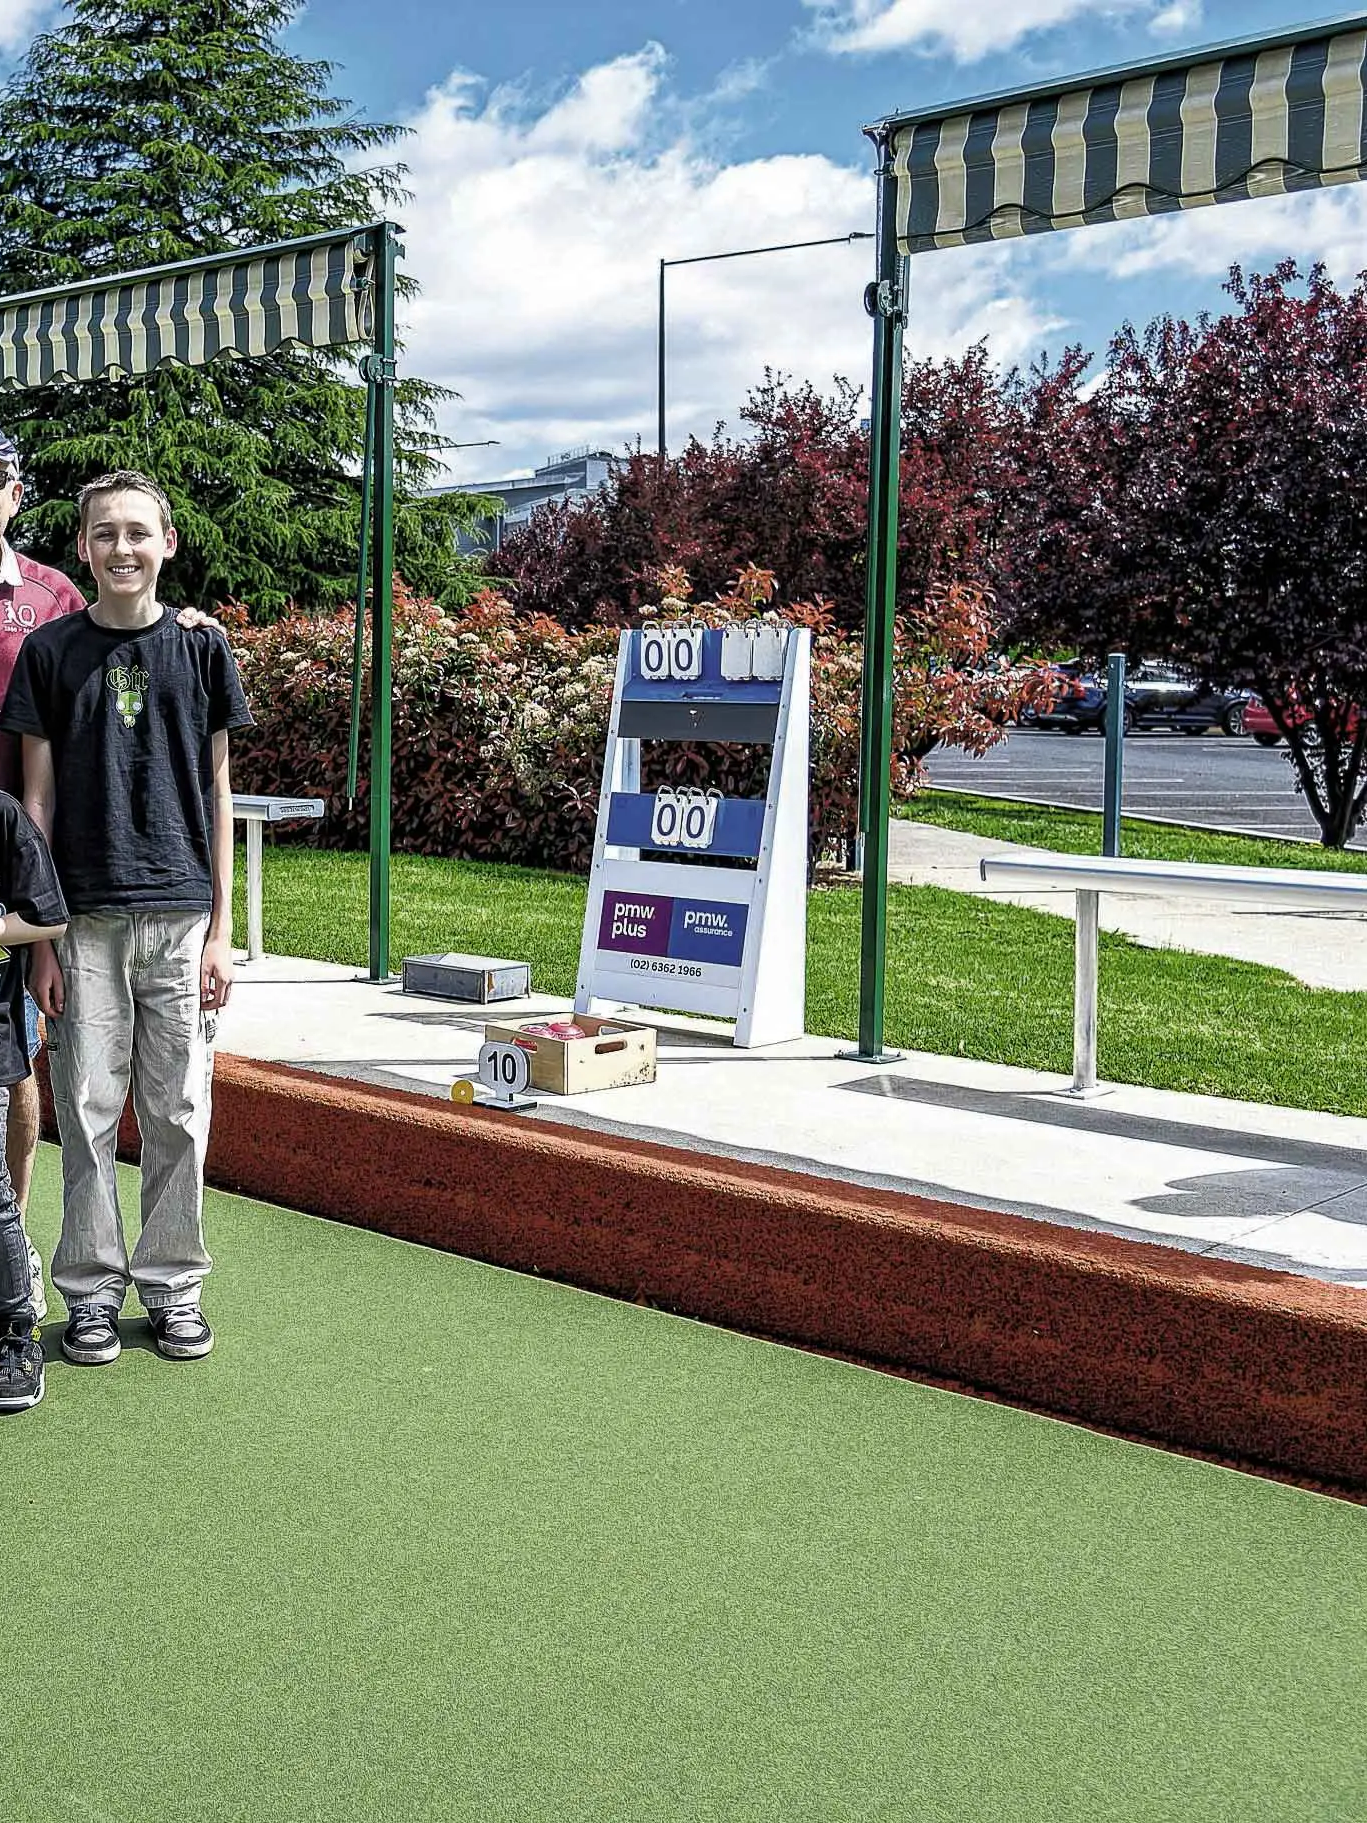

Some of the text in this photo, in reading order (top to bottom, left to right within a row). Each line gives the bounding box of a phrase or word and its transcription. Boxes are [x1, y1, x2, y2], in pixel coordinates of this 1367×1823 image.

[106, 664, 150, 691] Gir
[611, 918, 647, 939] plus
[693, 926, 733, 937] assurance
[630, 958, 702, 977] (02) 6362 1966
[486, 1050, 516, 1084] 10
